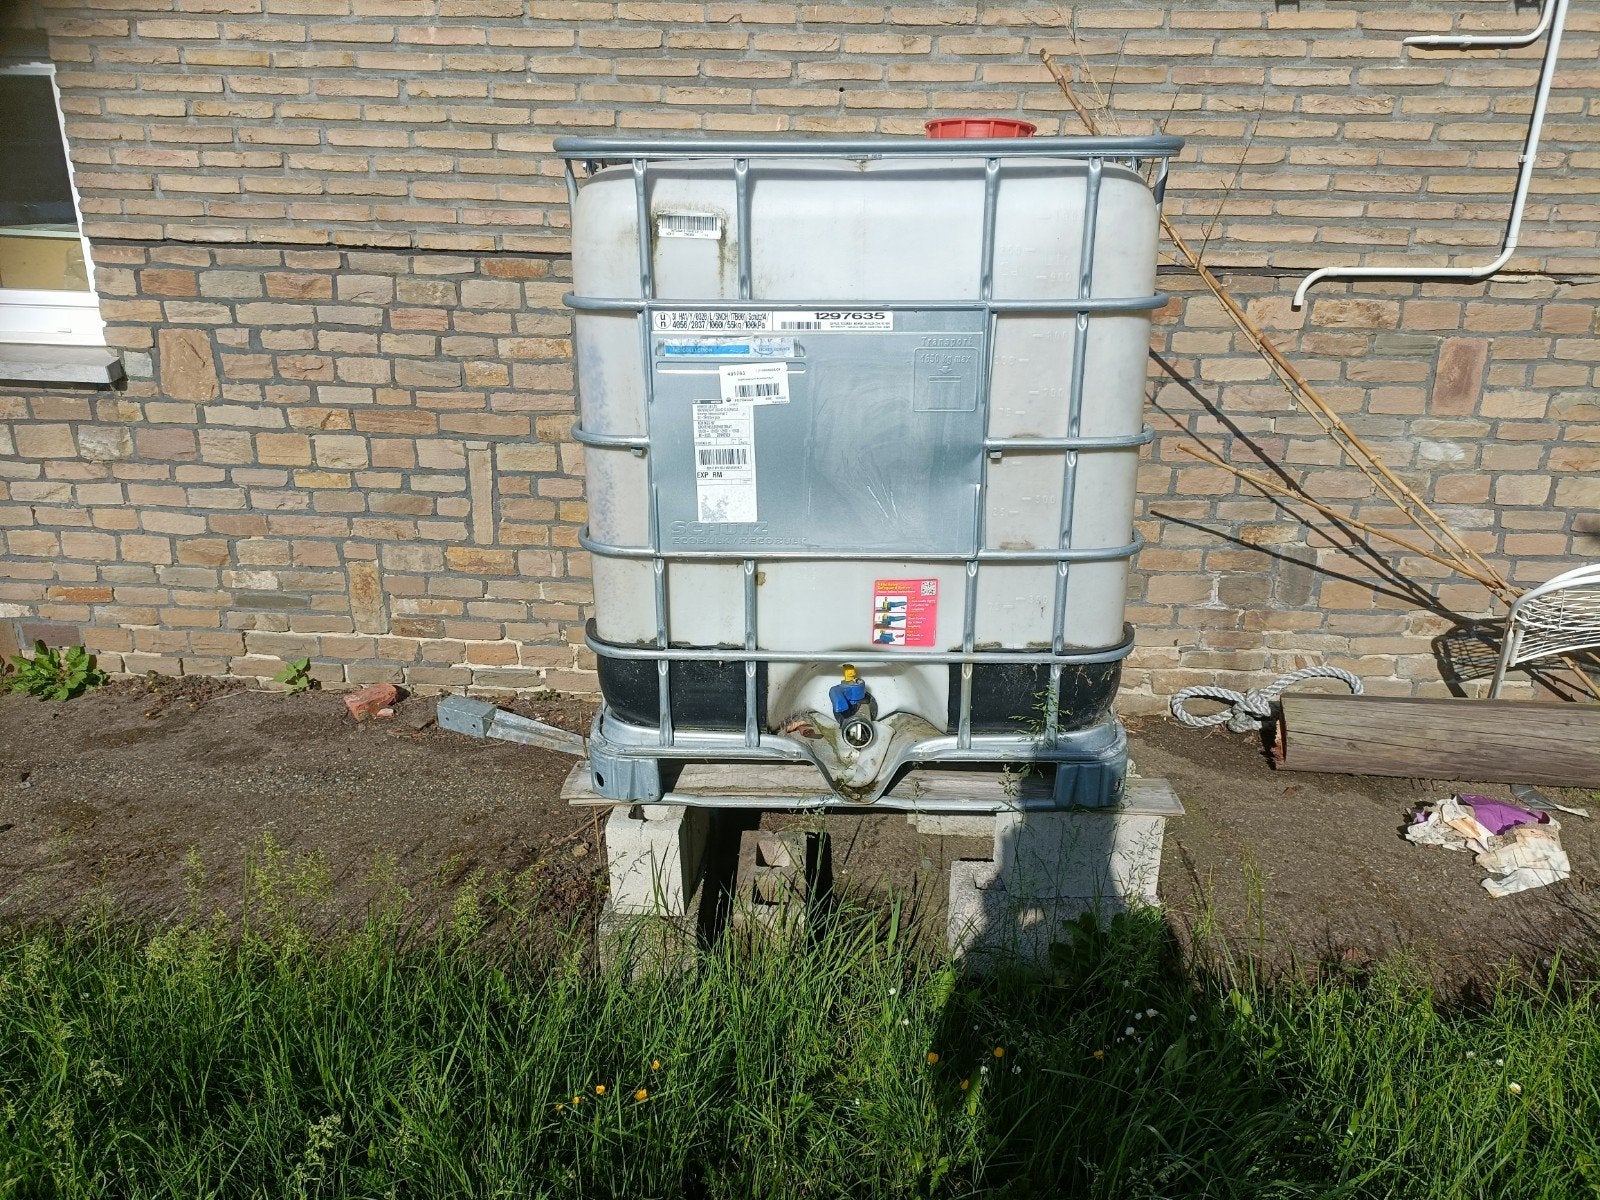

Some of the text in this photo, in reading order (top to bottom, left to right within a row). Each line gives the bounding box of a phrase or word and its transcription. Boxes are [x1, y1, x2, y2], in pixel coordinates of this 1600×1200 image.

[814, 312, 886, 320] 1297635
[921, 336, 974, 347] Transport
[697, 471, 709, 479] EXP
[1034, 494, 1057, 505] 500
